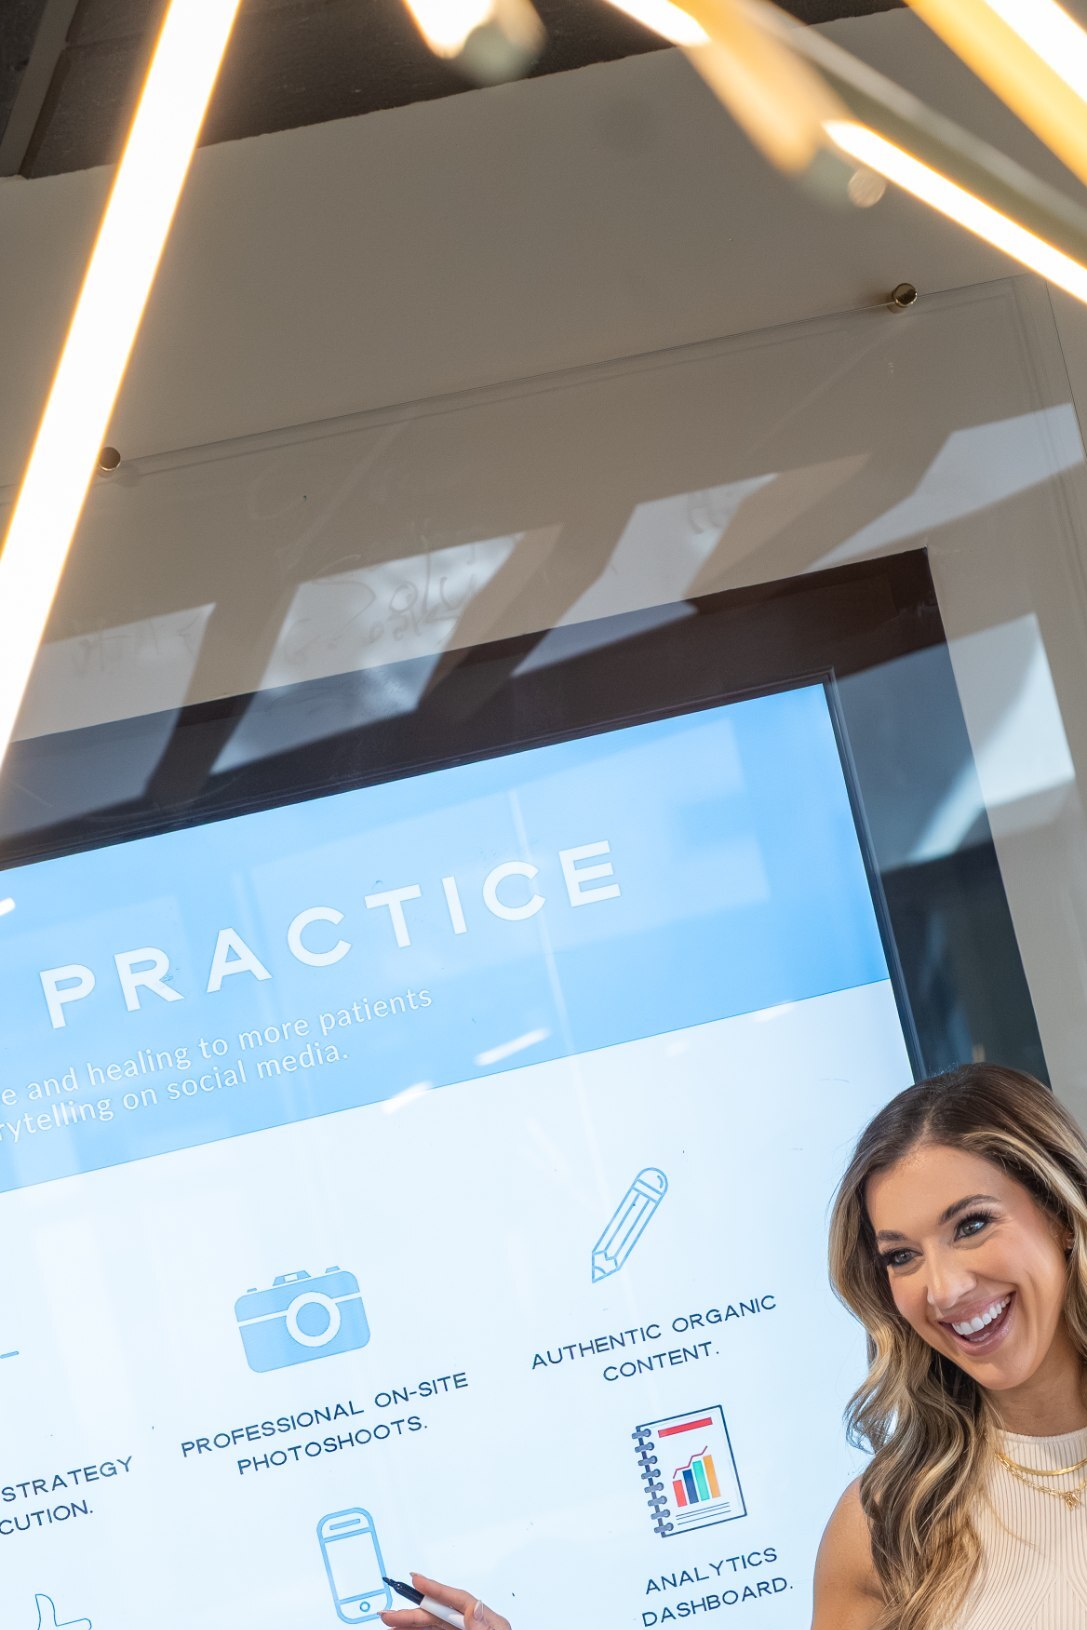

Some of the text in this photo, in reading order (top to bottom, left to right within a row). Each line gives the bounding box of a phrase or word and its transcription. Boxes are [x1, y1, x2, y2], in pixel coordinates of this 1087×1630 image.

[40, 840, 621, 1029] PRACTICE
[25, 1066, 79, 1100] and
[86, 1046, 192, 1087] healing
[199, 1037, 229, 1060] to
[239, 1018, 311, 1050] more
[319, 988, 433, 1036] patients
[123, 1087, 158, 1110] on
[167, 1060, 247, 1100] social
[256, 1040, 350, 1079] media.
[531, 1294, 777, 1370] AUTHENTIC ORGANIC
[603, 1341, 719, 1381] CONTENT.
[181, 1372, 469, 1458] PROFESSIONAL ON-SITE
[237, 1415, 428, 1475] PHOTOSHOOTS.
[1, 1455, 132, 1502] STRATEGY
[0, 1499, 94, 1535] CUTION.
[645, 1547, 778, 1595] ANALYTICS
[642, 1577, 794, 1628] DASHBOARD.
